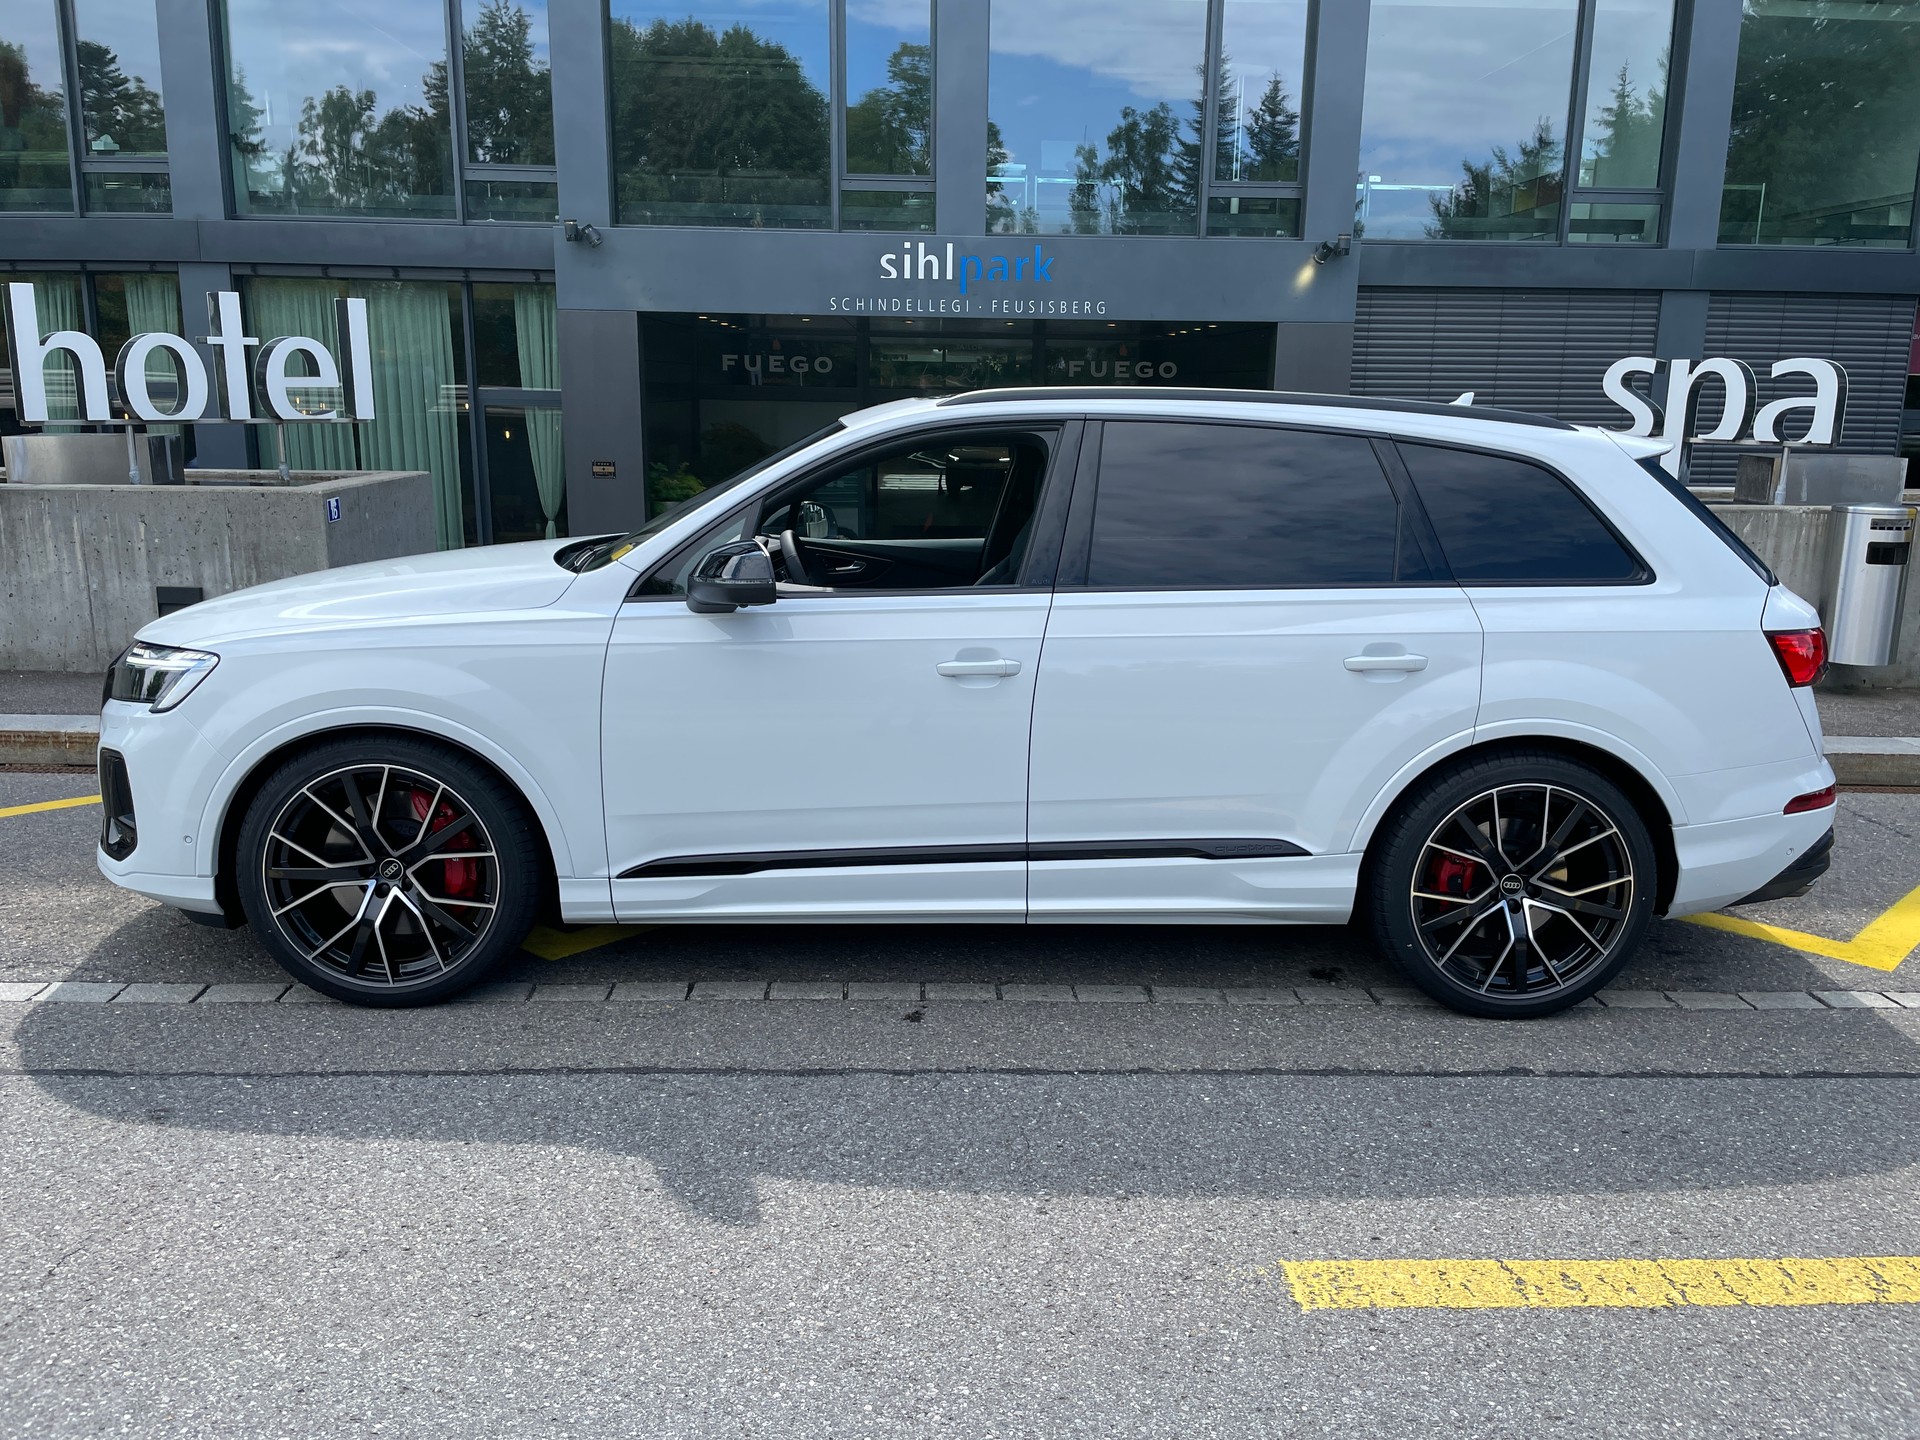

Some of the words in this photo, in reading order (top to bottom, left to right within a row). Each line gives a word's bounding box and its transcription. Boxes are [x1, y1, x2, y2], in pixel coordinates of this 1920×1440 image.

[879, 241, 1055, 295] sihlpark
[829, 297, 970, 314] SCHINDELLEGI
[991, 300, 1107, 315] FEUSISBERG
[4, 281, 375, 422] hotel
[721, 354, 833, 374] FUEGO
[1067, 360, 1178, 379] FUEGO
[1602, 356, 1849, 480] spa
